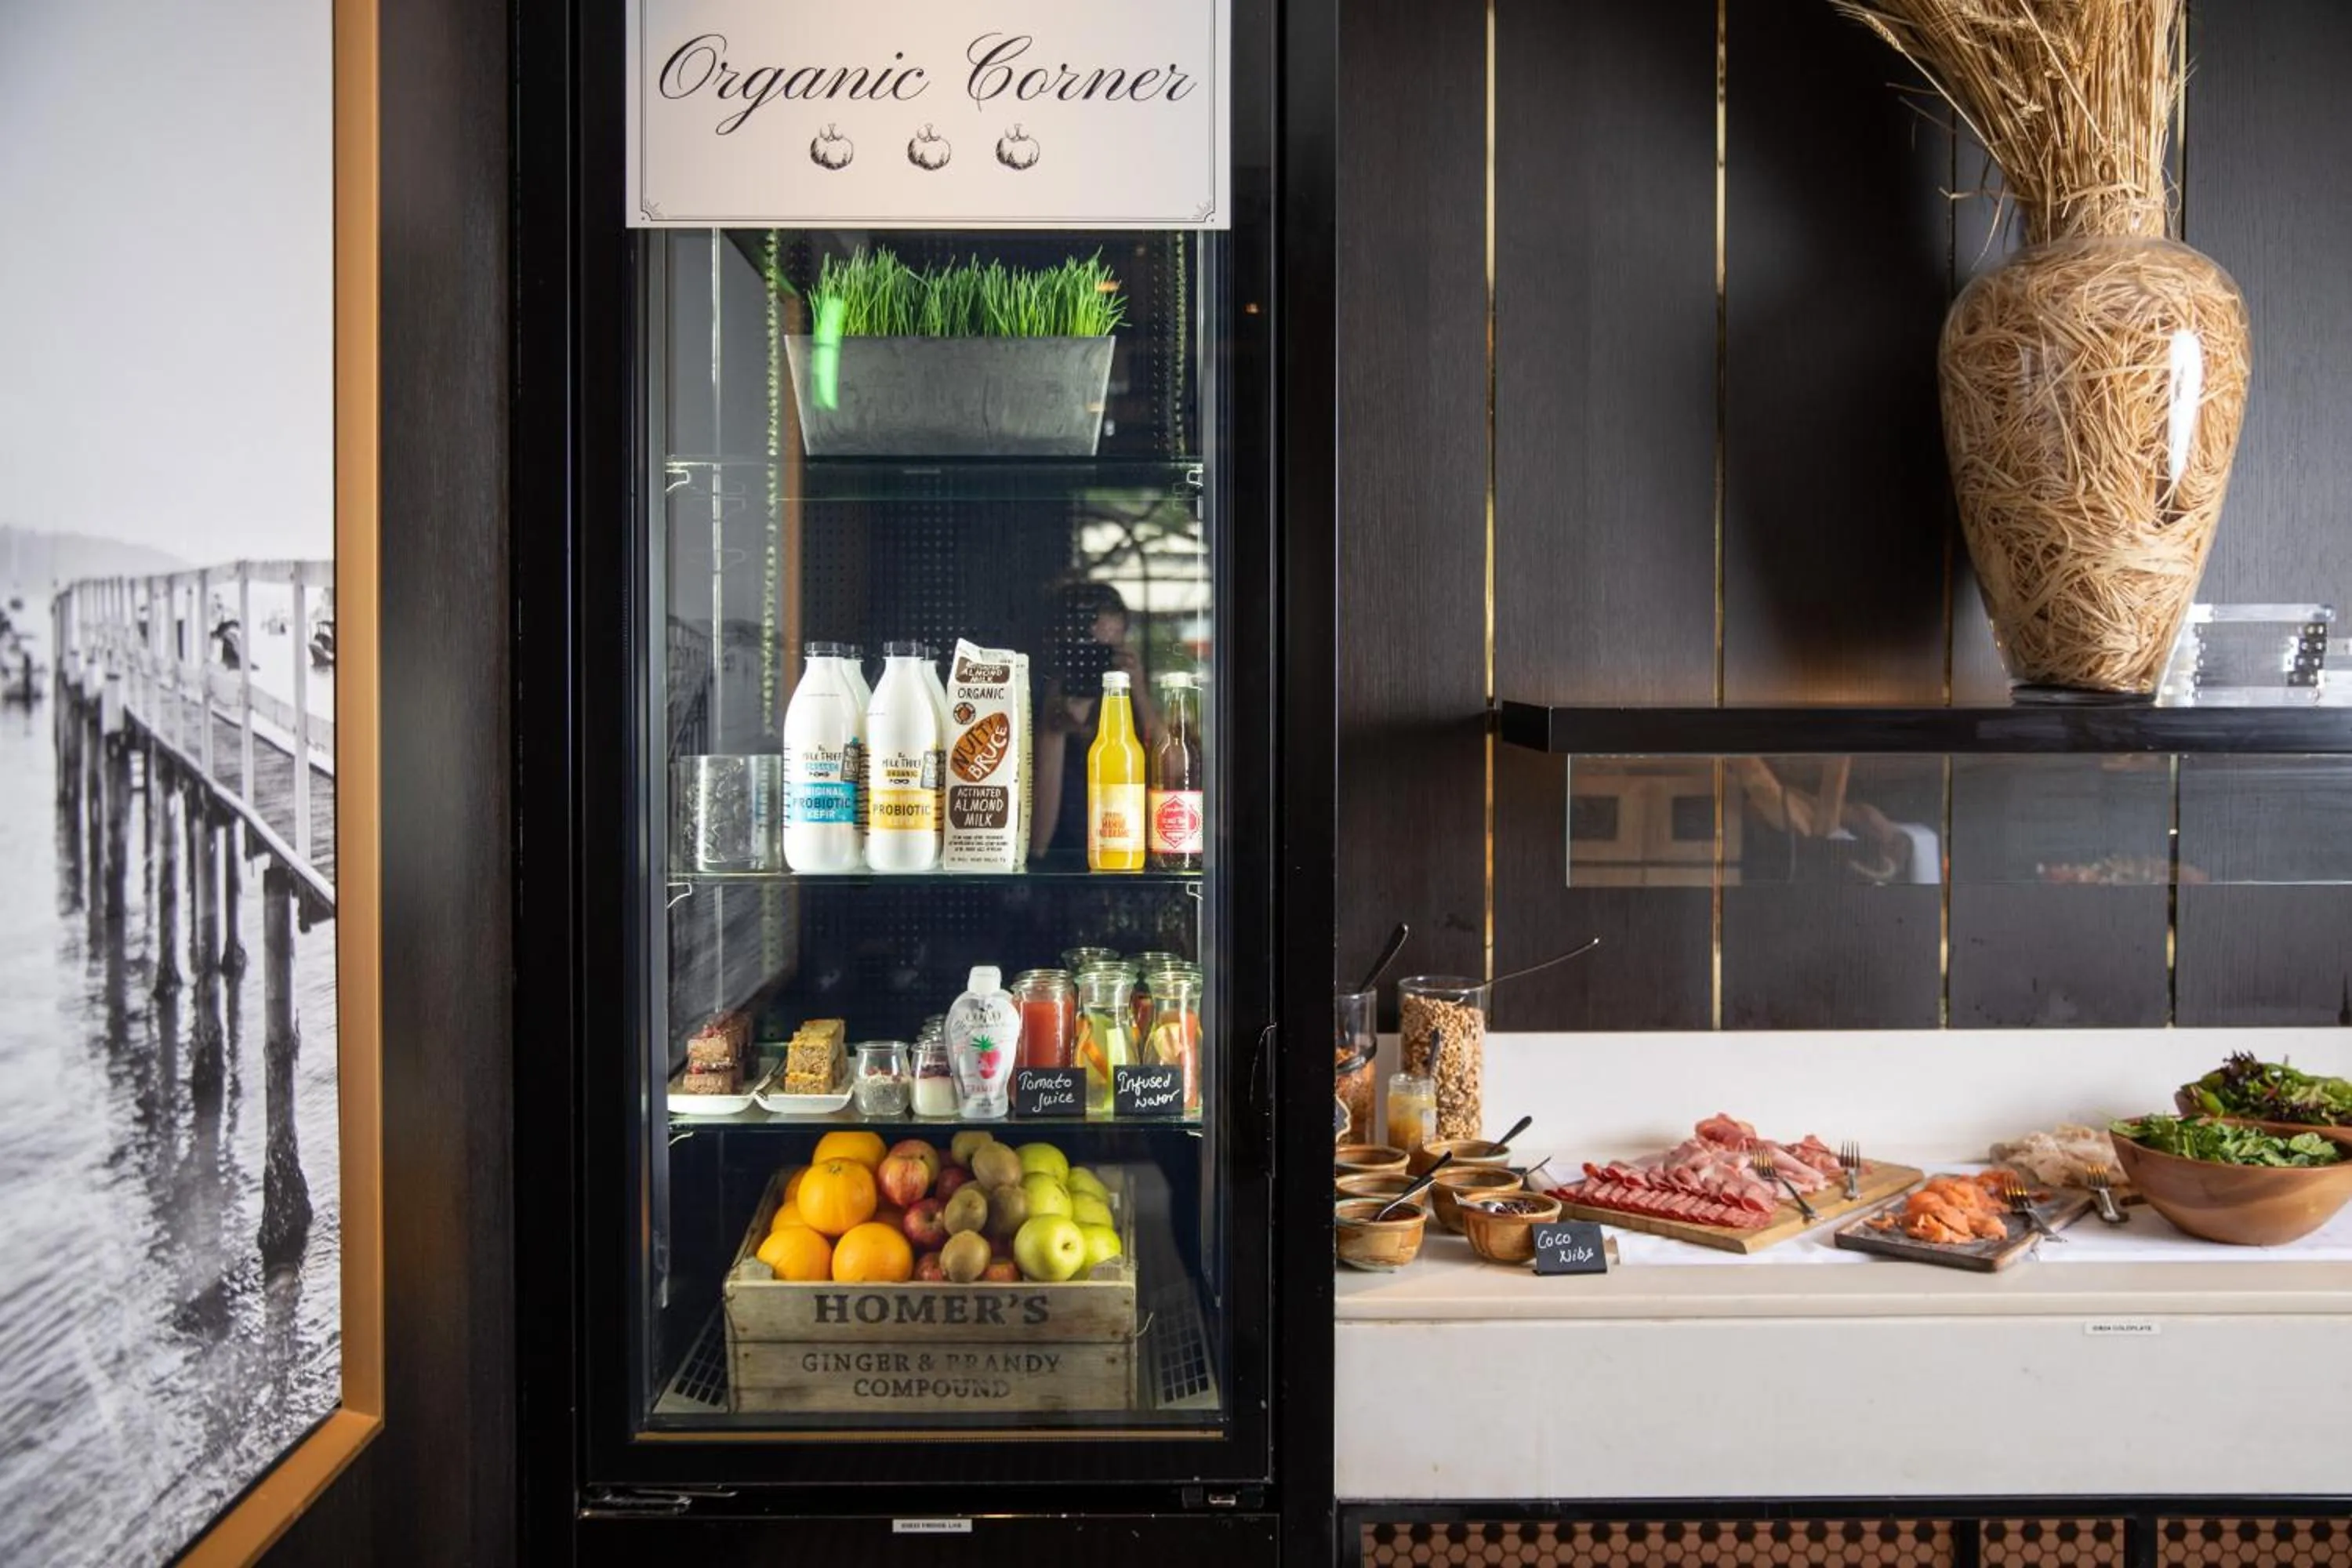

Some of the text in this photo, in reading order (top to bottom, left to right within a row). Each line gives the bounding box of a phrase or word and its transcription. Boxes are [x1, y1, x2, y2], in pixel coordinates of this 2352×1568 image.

[659, 32, 1199, 136] Organic Corner
[957, 687, 1004, 699] ORGANIC
[952, 713, 995, 771] NUTTY
[967, 725, 1007, 780] BRUCE
[957, 788, 1001, 797] ACTIVATED
[793, 797, 851, 809] PROBIOTIC
[873, 804, 931, 815] PROBIOTIC
[953, 799, 1004, 812] ALMOND
[964, 812, 993, 826] MILK
[1018, 1071, 1073, 1091] Tomato
[1117, 1071, 1171, 1096] Infused
[1537, 1229, 1572, 1249] Coco
[814, 1294, 1050, 1325] HOMER'S
[802, 1353, 912, 1373] GINGER
[918, 1354, 935, 1373] &
[853, 1378, 1011, 1399] COMPOUND
